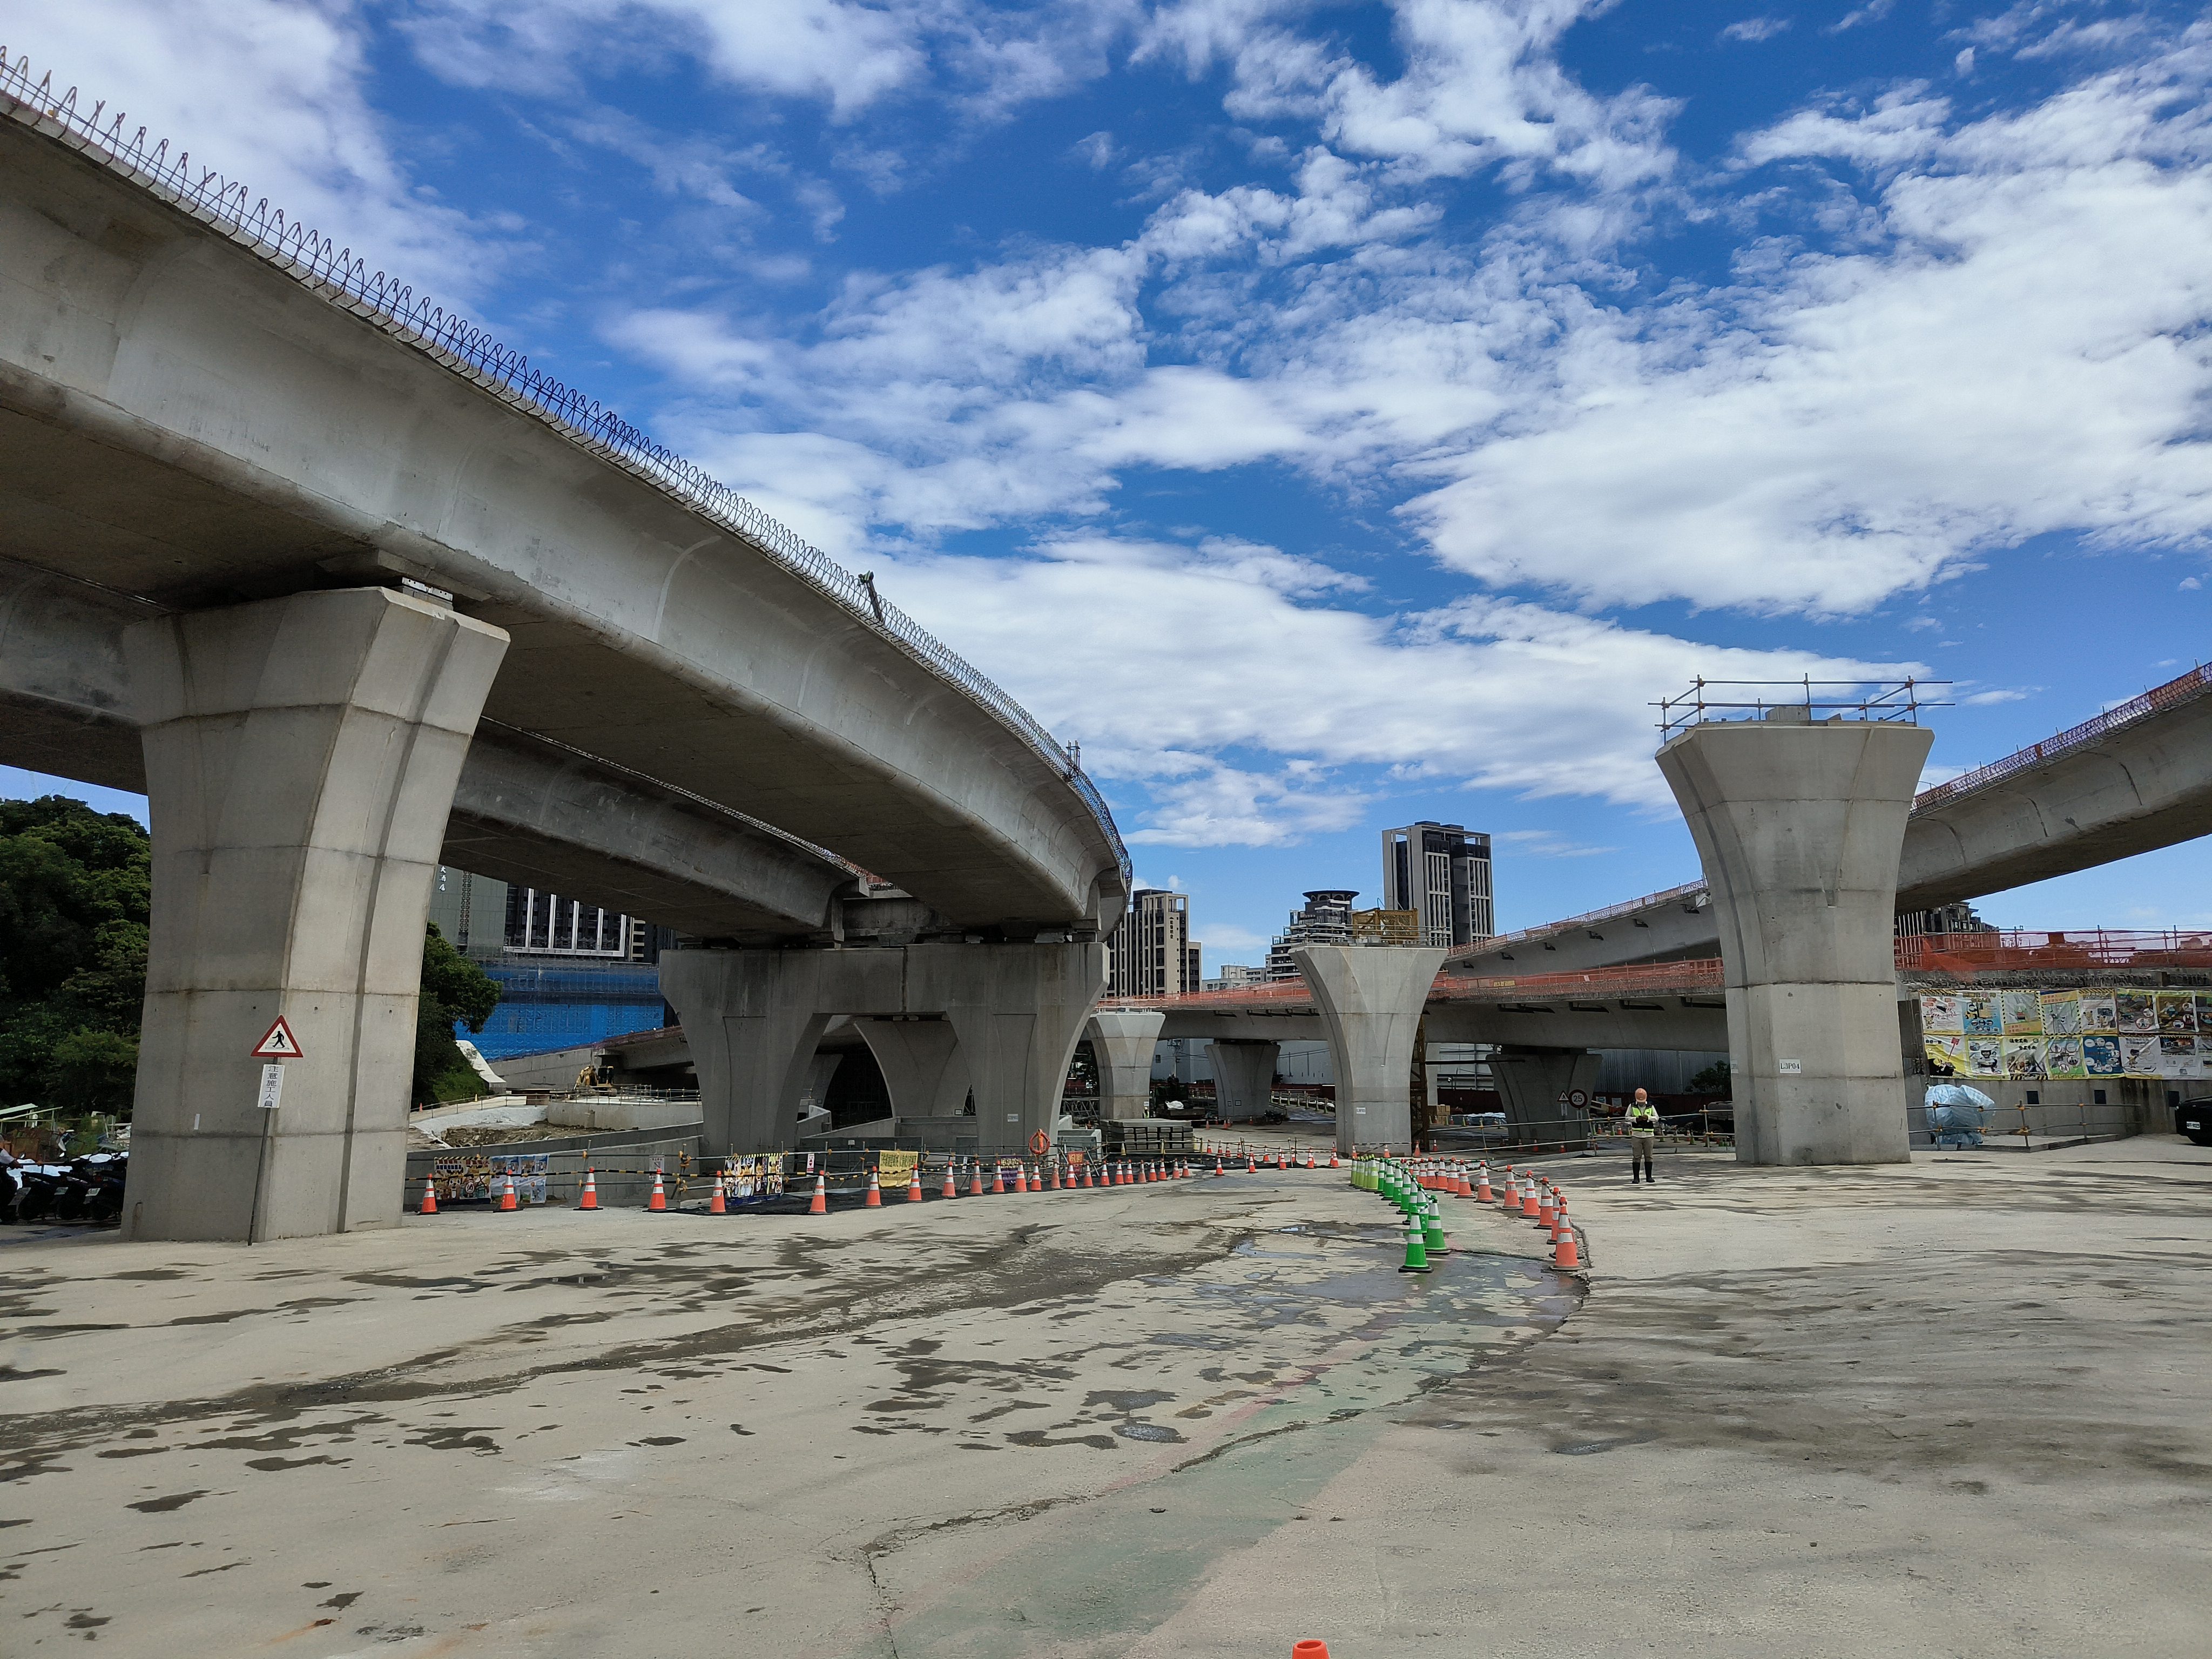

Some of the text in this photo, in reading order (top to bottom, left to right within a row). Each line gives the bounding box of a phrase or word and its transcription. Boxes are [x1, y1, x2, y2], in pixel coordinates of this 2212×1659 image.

[264, 1065, 279, 1107] 注意施工人員
